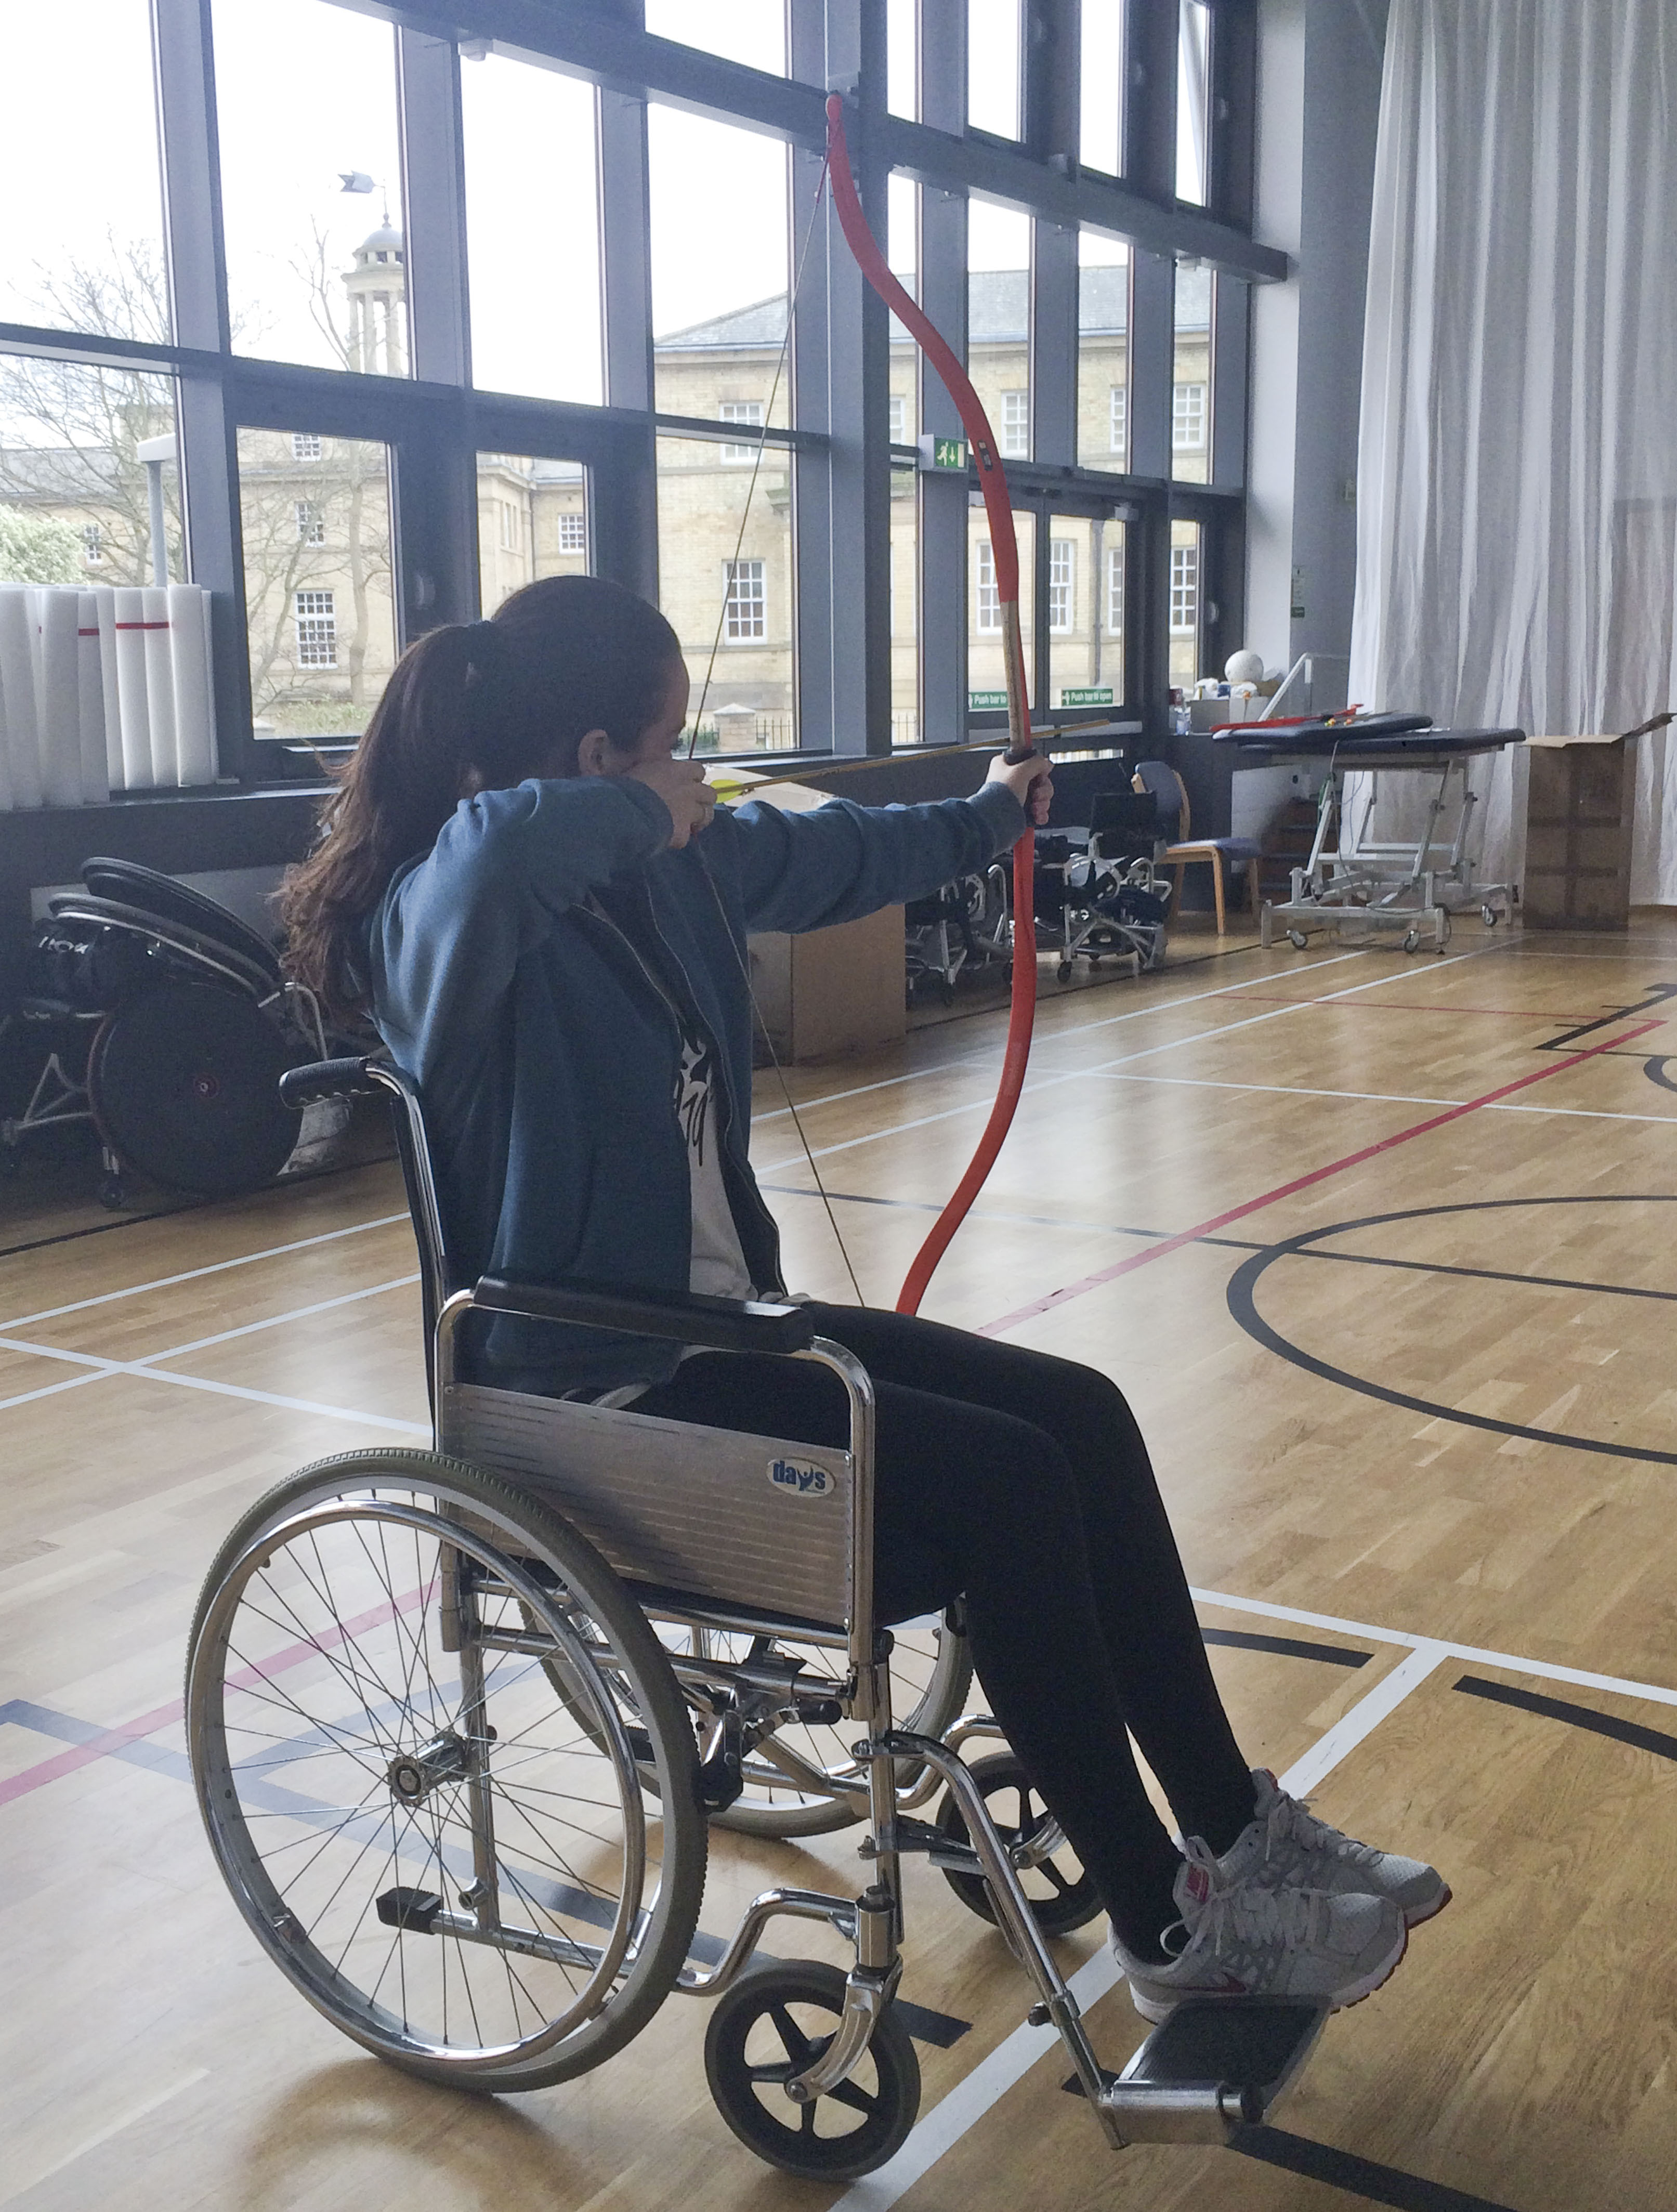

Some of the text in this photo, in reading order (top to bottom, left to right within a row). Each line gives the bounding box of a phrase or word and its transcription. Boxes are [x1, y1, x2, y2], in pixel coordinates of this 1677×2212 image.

[974, 695, 990, 705] Push
[1071, 692, 1084, 701] Push
[1099, 692, 1111, 702] open
[773, 1460, 826, 1491] days
